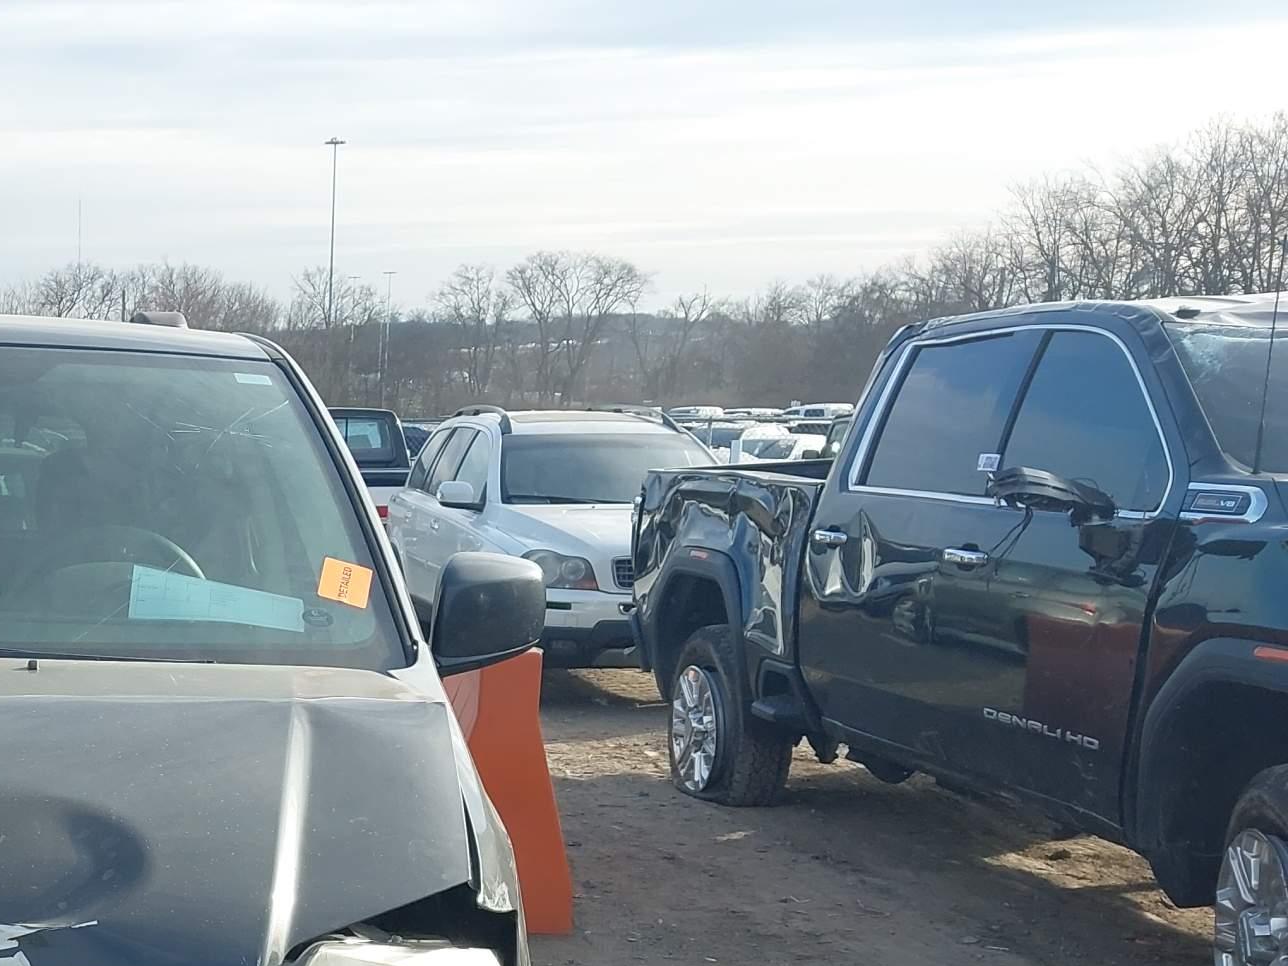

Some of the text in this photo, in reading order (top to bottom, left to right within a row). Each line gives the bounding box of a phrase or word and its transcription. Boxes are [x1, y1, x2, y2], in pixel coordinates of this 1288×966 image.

[337, 566, 353, 598] DETAILED
[983, 707, 1100, 750] DENALI HD
